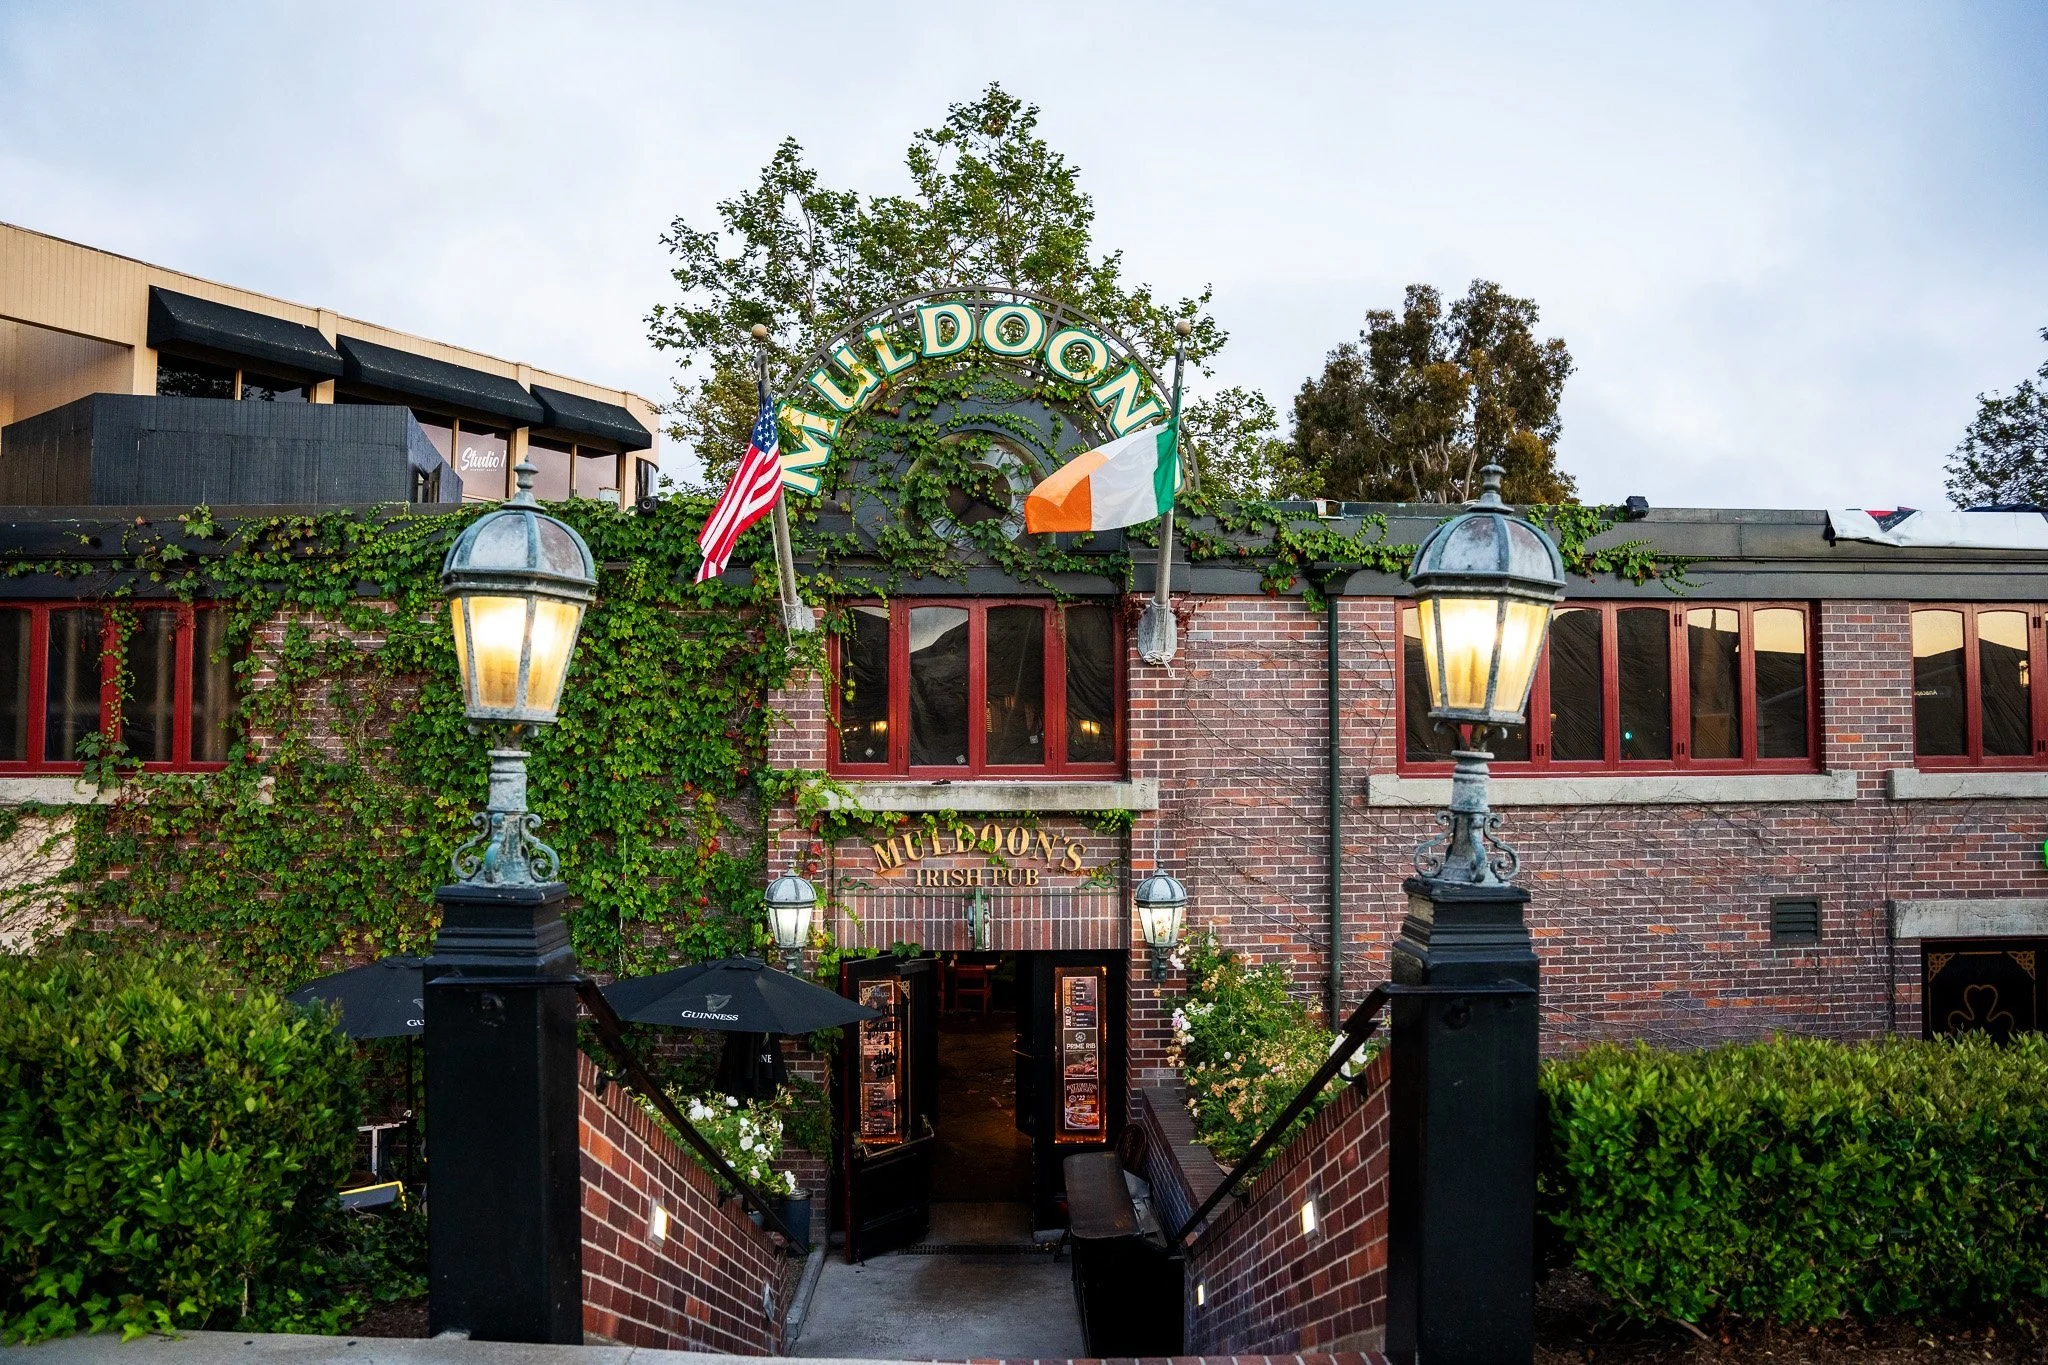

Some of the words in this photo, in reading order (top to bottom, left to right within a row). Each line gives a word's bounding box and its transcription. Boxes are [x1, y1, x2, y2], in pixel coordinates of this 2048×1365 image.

[779, 301, 1184, 497] MULDOON
[460, 447, 499, 471] Studio
[870, 822, 1088, 873] MULDOON'S
[915, 868, 982, 888] IRISH
[991, 868, 1040, 888] PUB
[681, 1010, 740, 1021] GUINNESS
